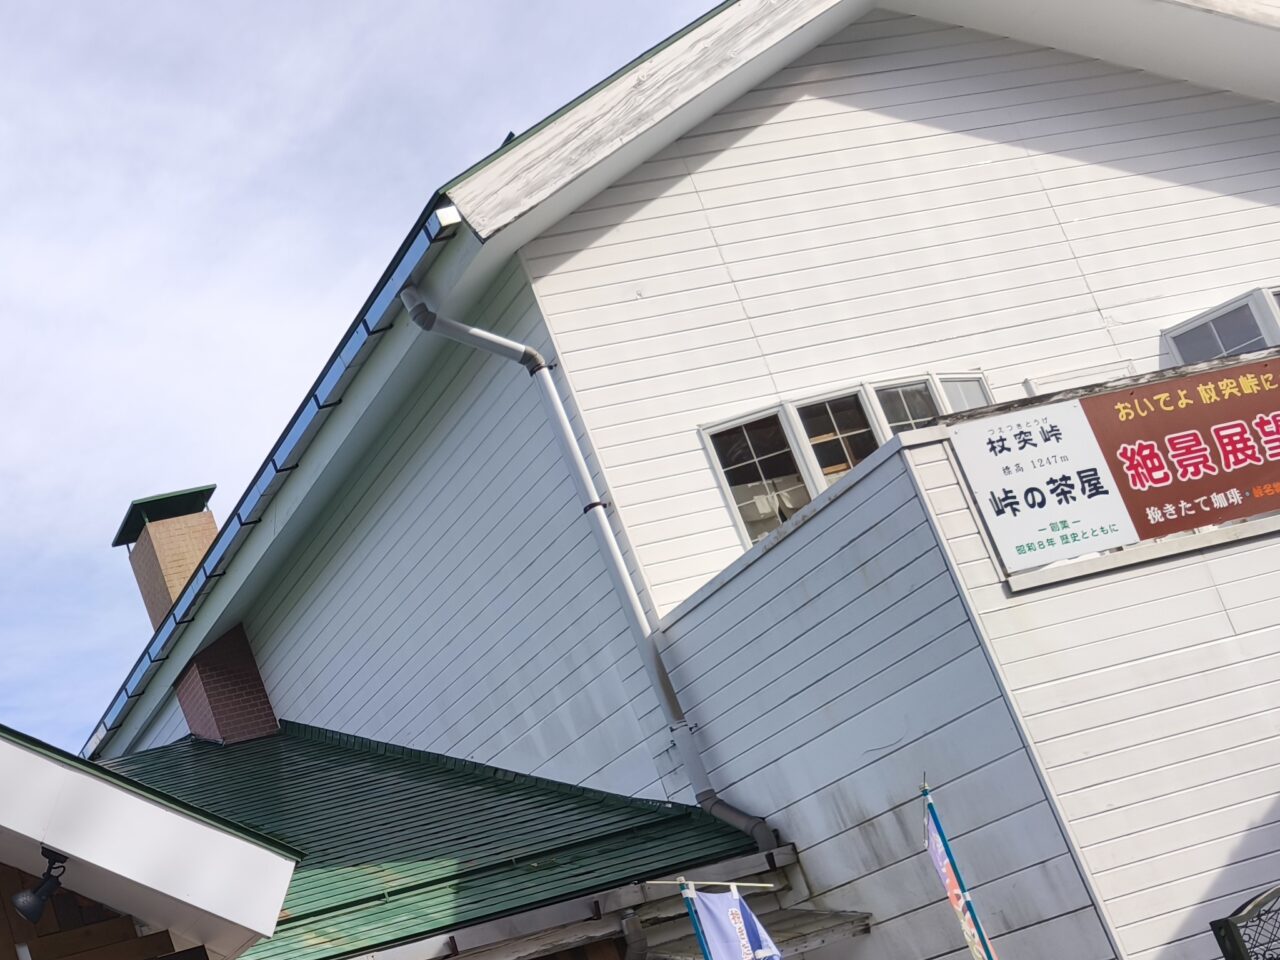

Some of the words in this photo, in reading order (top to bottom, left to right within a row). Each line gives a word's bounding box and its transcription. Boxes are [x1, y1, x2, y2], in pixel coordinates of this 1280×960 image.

[1114, 389, 1194, 421] おいでよ
[1197, 373, 1279, 404] 杖突峠に
[986, 424, 1063, 457] 杖突峠
[988, 417, 1048, 436] つえつきとうげ
[988, 467, 1110, 517] 峠の茶屋
[1059, 523, 1119, 546] 歴史とともに
